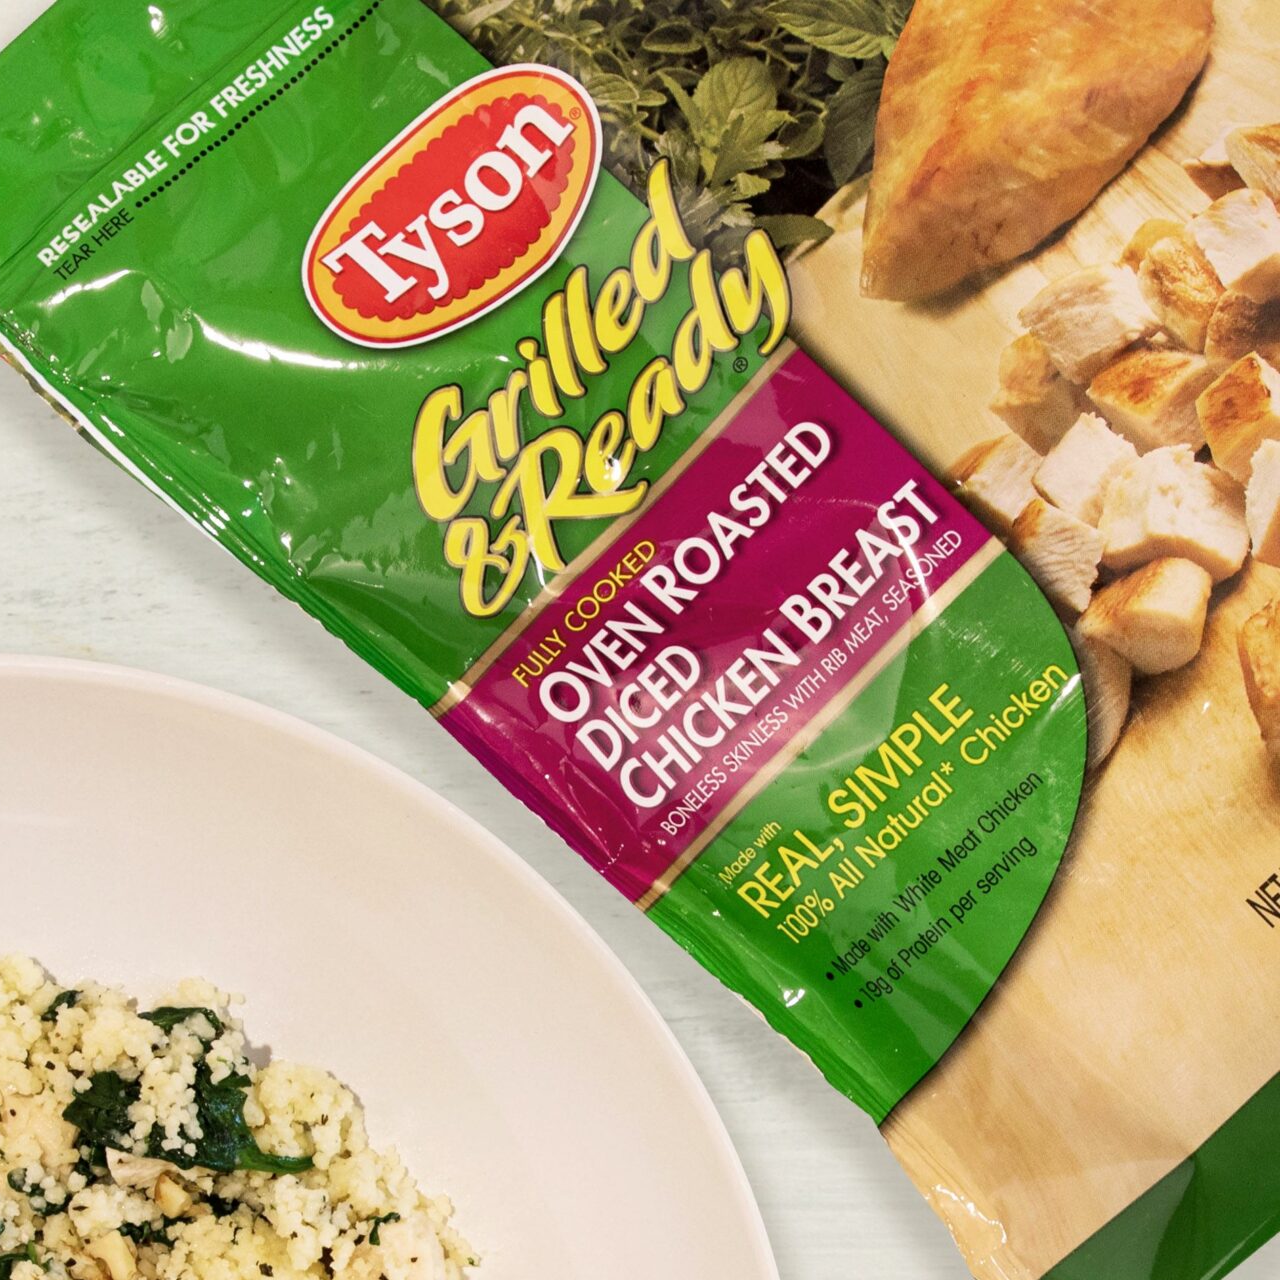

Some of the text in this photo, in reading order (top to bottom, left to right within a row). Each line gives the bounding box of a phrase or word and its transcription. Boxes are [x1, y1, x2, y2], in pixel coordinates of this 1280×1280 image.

[36, 6, 335, 267] RESEALABLE FOR FRESHNESS
[53, 208, 134, 280] TEAR HERE
[320, 103, 577, 303] Tyson
[412, 156, 696, 521] Grilled
[444, 228, 792, 618] & Ready
[511, 540, 656, 688] FULLY COOKED
[538, 421, 831, 723] OVEN ROASTED
[619, 479, 938, 808] CHICKEN BREAST
[660, 529, 962, 836] BONELESS SKINLESS WITH RIB MEAT, SEASONED
[575, 645, 701, 772] DICED
[736, 683, 974, 919] REAL, SIMPLE
[776, 889, 835, 943] 100%
[828, 857, 865, 900] All
[960, 664, 1069, 765] Chicken
[717, 820, 782, 886] Made with
[831, 771, 1044, 976] Made with White Meat Chicken
[859, 836, 1038, 1001] 19g of Protein per serving
